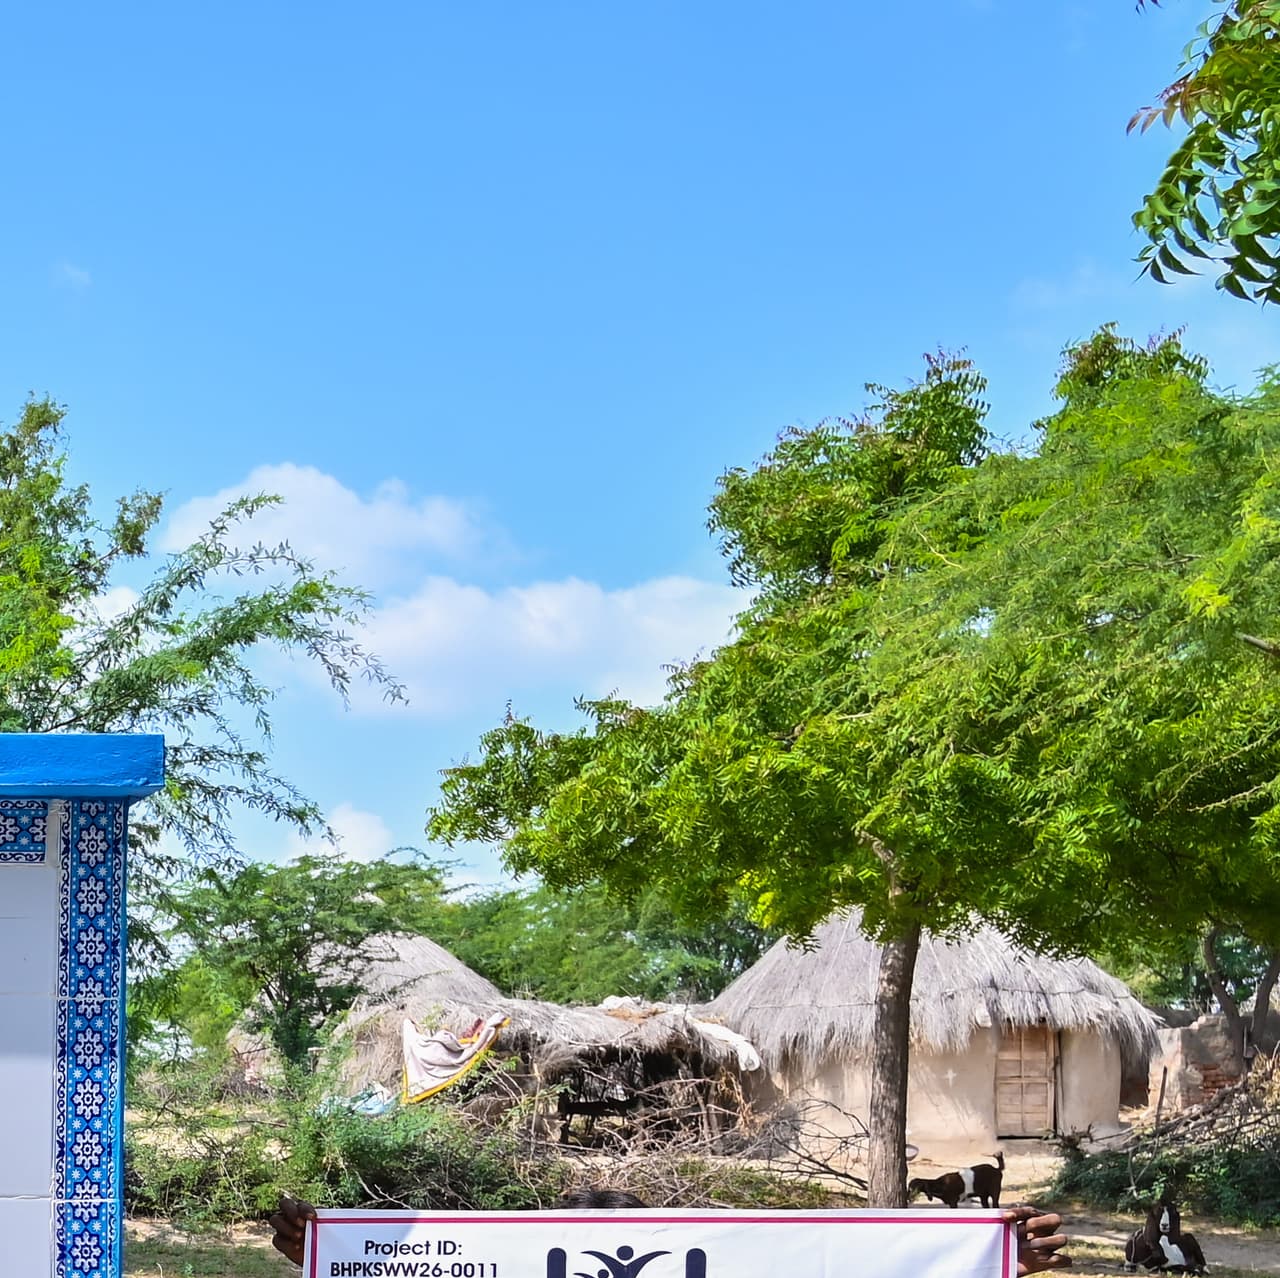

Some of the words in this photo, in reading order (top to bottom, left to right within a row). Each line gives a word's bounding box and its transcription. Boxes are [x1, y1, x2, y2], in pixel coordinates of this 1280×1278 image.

[364, 1240, 431, 1258] Project
[437, 1240, 462, 1255] ID:
[330, 1262, 497, 1278] BHPKSWW26-0011
